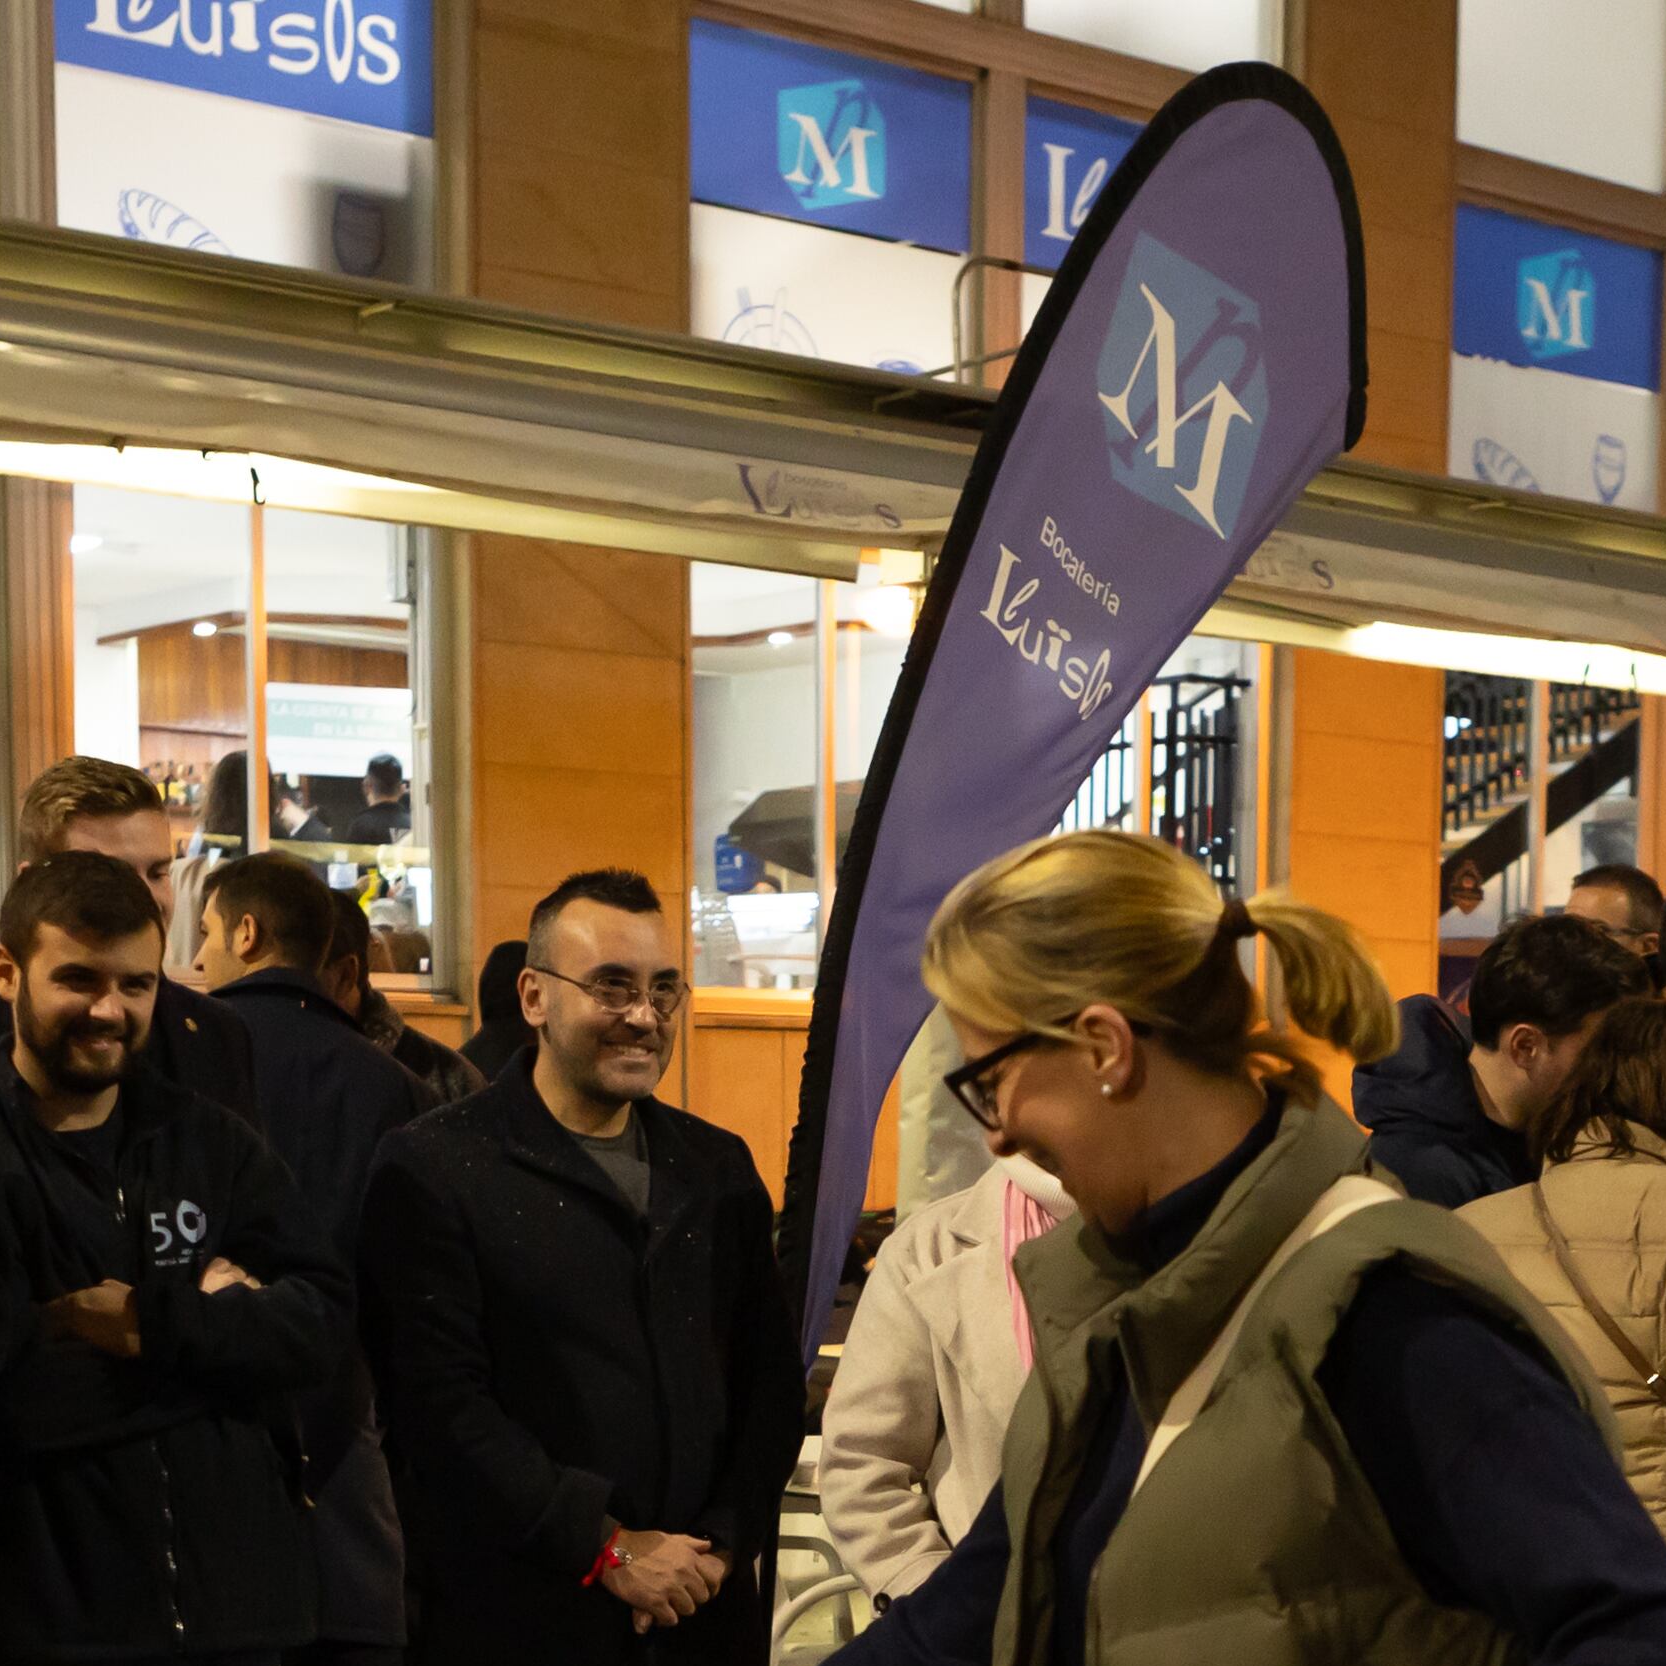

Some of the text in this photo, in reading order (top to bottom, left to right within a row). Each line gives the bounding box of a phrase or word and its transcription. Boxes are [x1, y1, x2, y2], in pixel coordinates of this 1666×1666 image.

[785, 112, 880, 199] M
[1522, 279, 1589, 348] M
[1098, 283, 1252, 540] M
[1040, 516, 1120, 617] Bocatería
